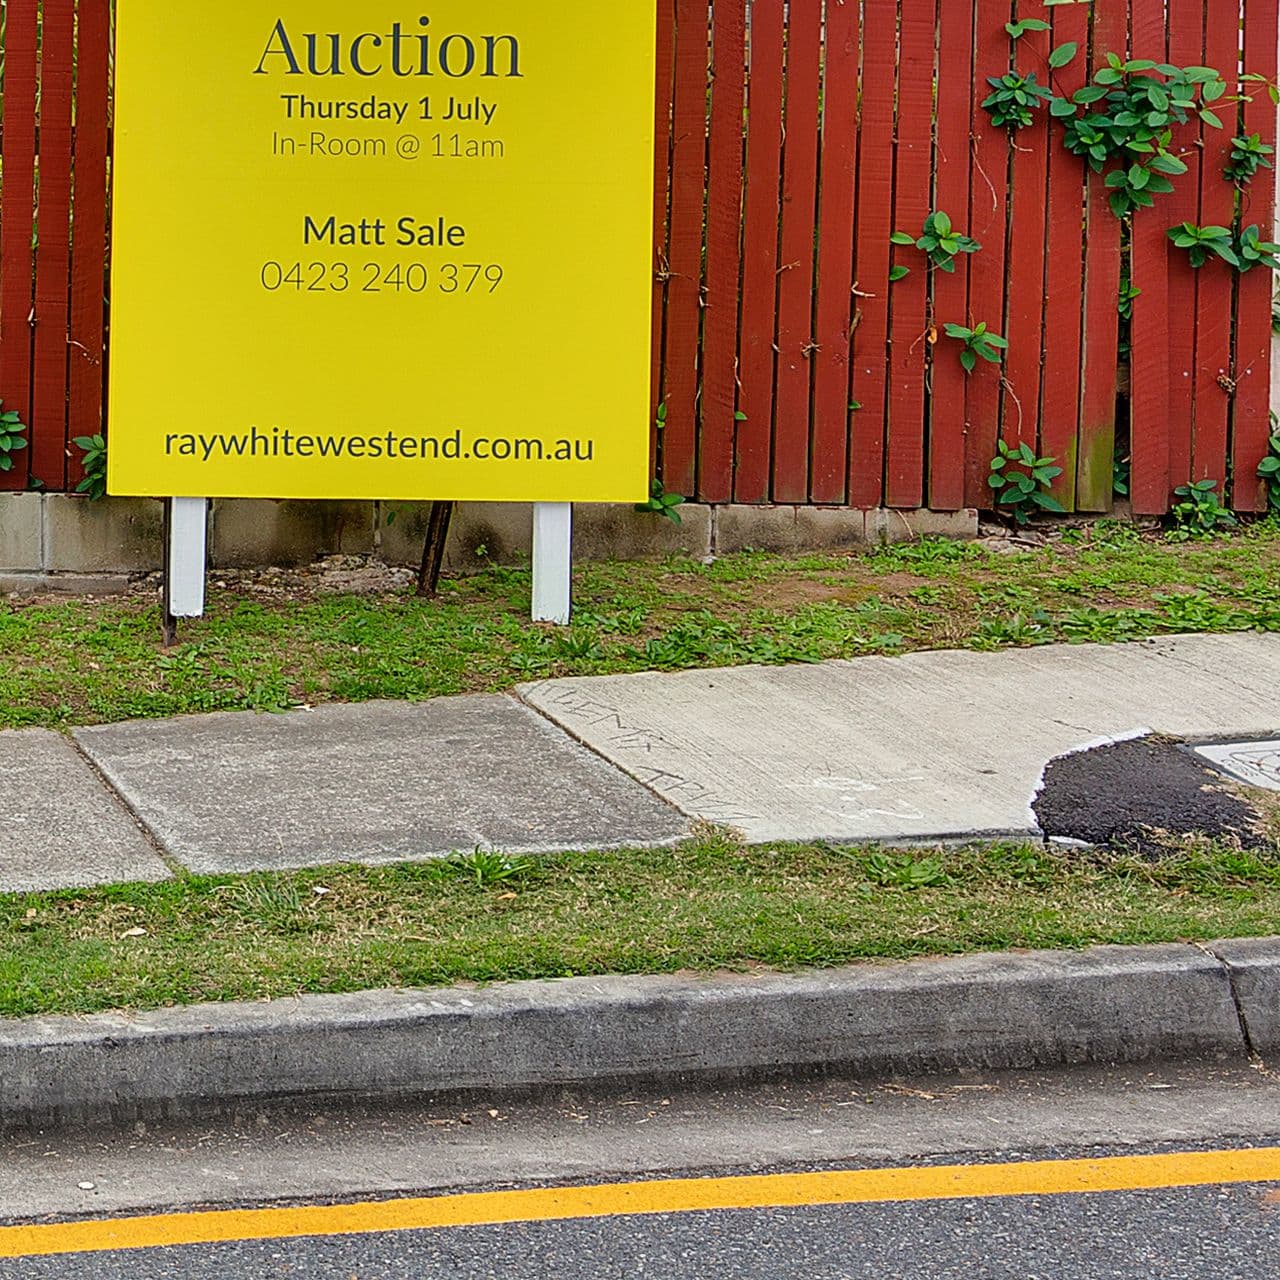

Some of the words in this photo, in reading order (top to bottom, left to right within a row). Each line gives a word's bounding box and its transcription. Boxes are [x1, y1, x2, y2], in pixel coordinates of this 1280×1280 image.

[253, 16, 524, 78] Auction
[280, 95, 408, 125] Thursday
[418, 96, 432, 120] 1
[442, 96, 497, 125] July
[272, 131, 386, 157] In-Room
[395, 133, 421, 160] @
[431, 133, 504, 158] 11am
[303, 216, 385, 246] Matt
[396, 216, 466, 246] Sale
[261, 261, 349, 291] 0423
[362, 262, 428, 292] 240
[438, 263, 504, 293] 379
[165, 426, 593, 461] raywhitewestend.com.au
